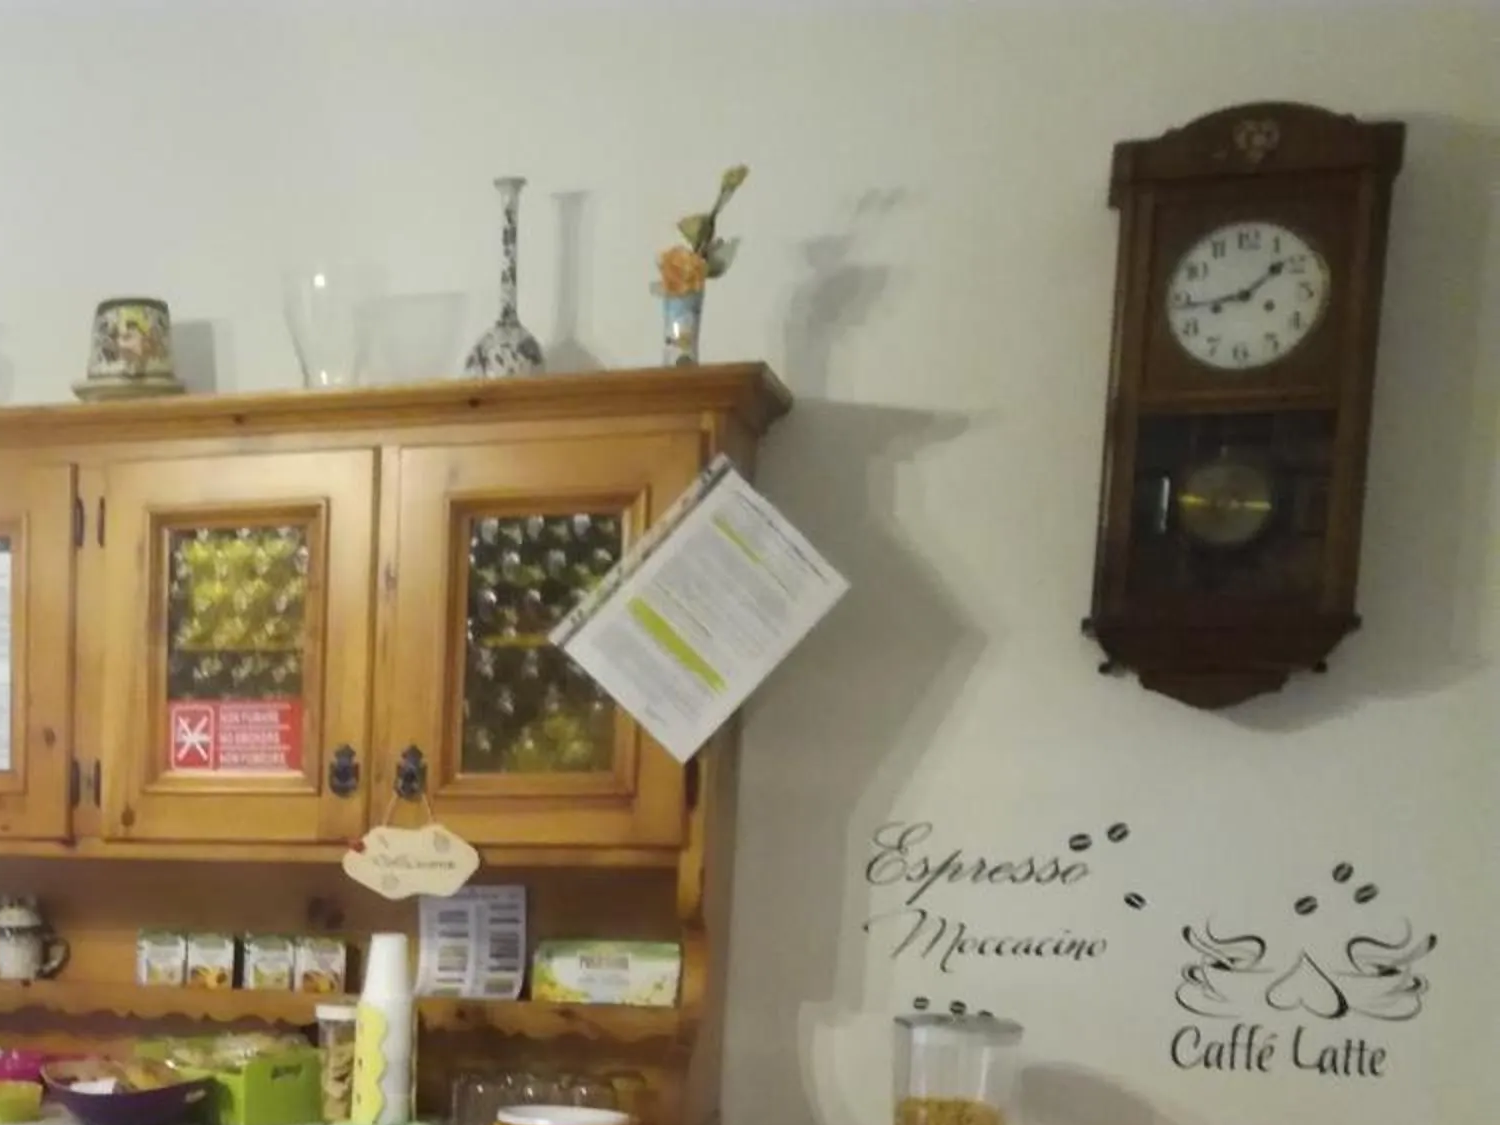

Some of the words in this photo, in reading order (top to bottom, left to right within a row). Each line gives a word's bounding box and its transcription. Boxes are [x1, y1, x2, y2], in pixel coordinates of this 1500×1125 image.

[866, 821, 1089, 905] Espresso
[863, 908, 1107, 973] Moccacino
[1171, 1023, 1278, 1072] Caffé
[1293, 1026, 1386, 1077] Latte
